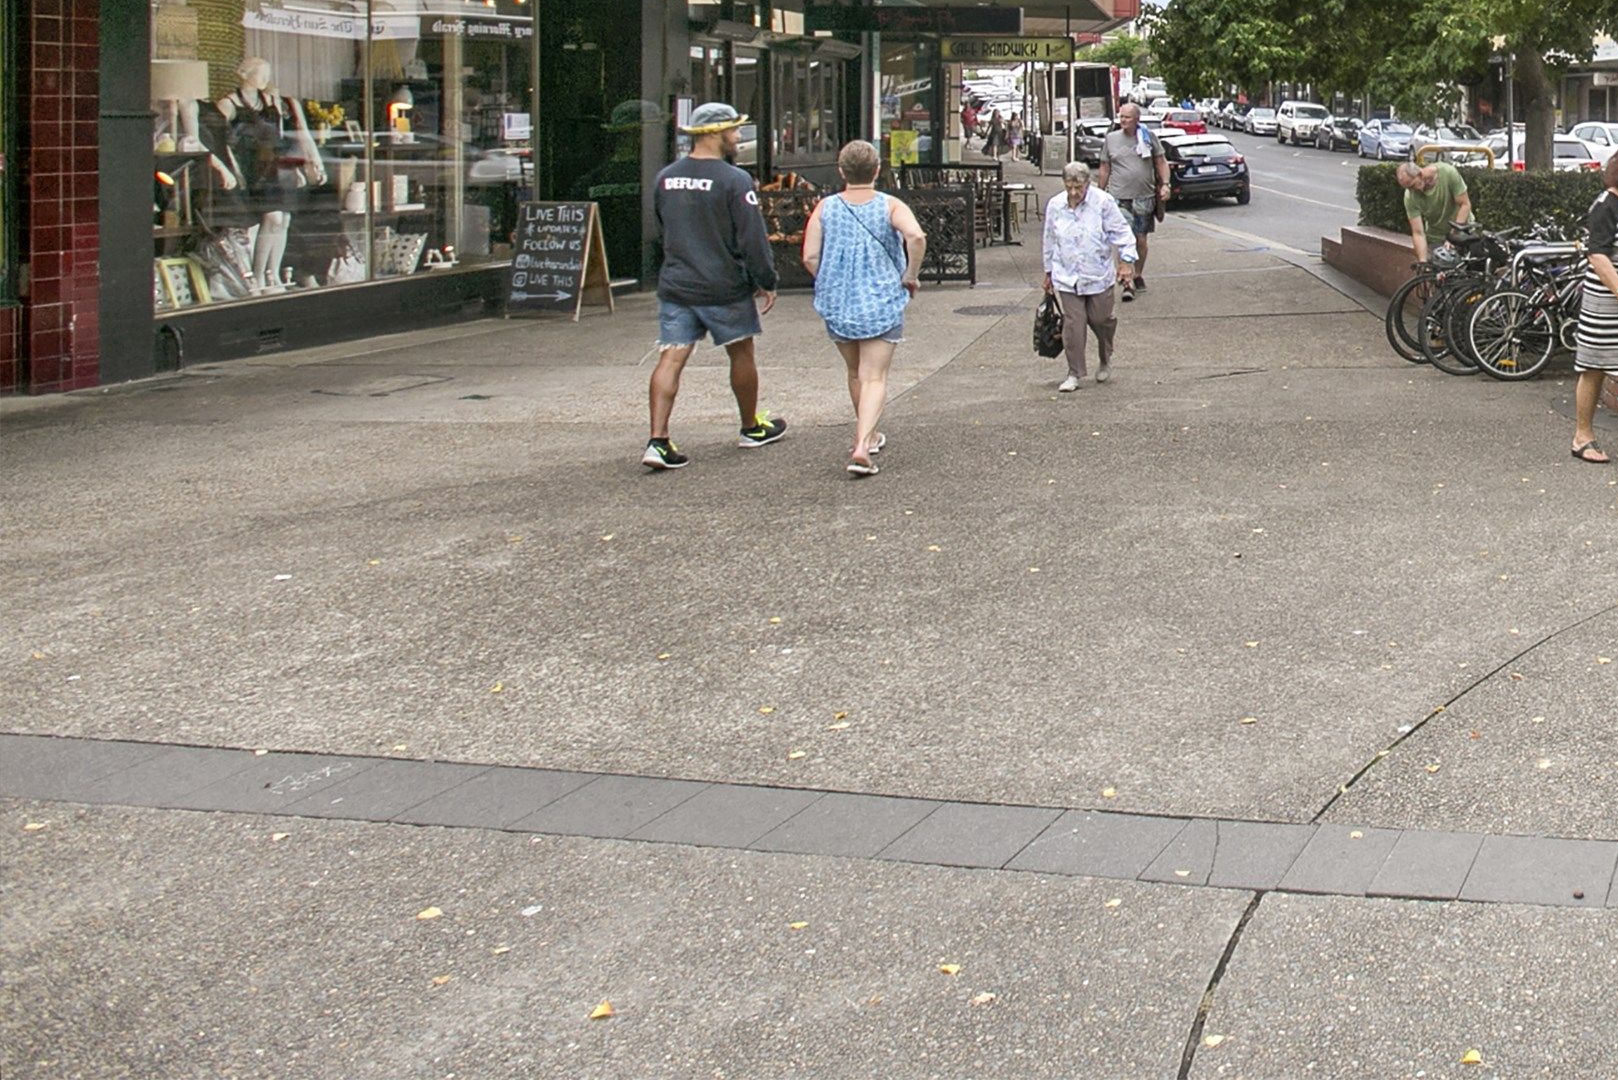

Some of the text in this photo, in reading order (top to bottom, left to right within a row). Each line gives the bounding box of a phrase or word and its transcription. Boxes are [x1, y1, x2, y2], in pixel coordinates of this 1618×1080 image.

[981, 41, 1038, 58] RANDWICK
[664, 177, 713, 191] DEFUNCT
[526, 205, 584, 222] LIVE THIS
[523, 240, 581, 251] FOLLOW US
[529, 272, 574, 287] LIVE THIS
